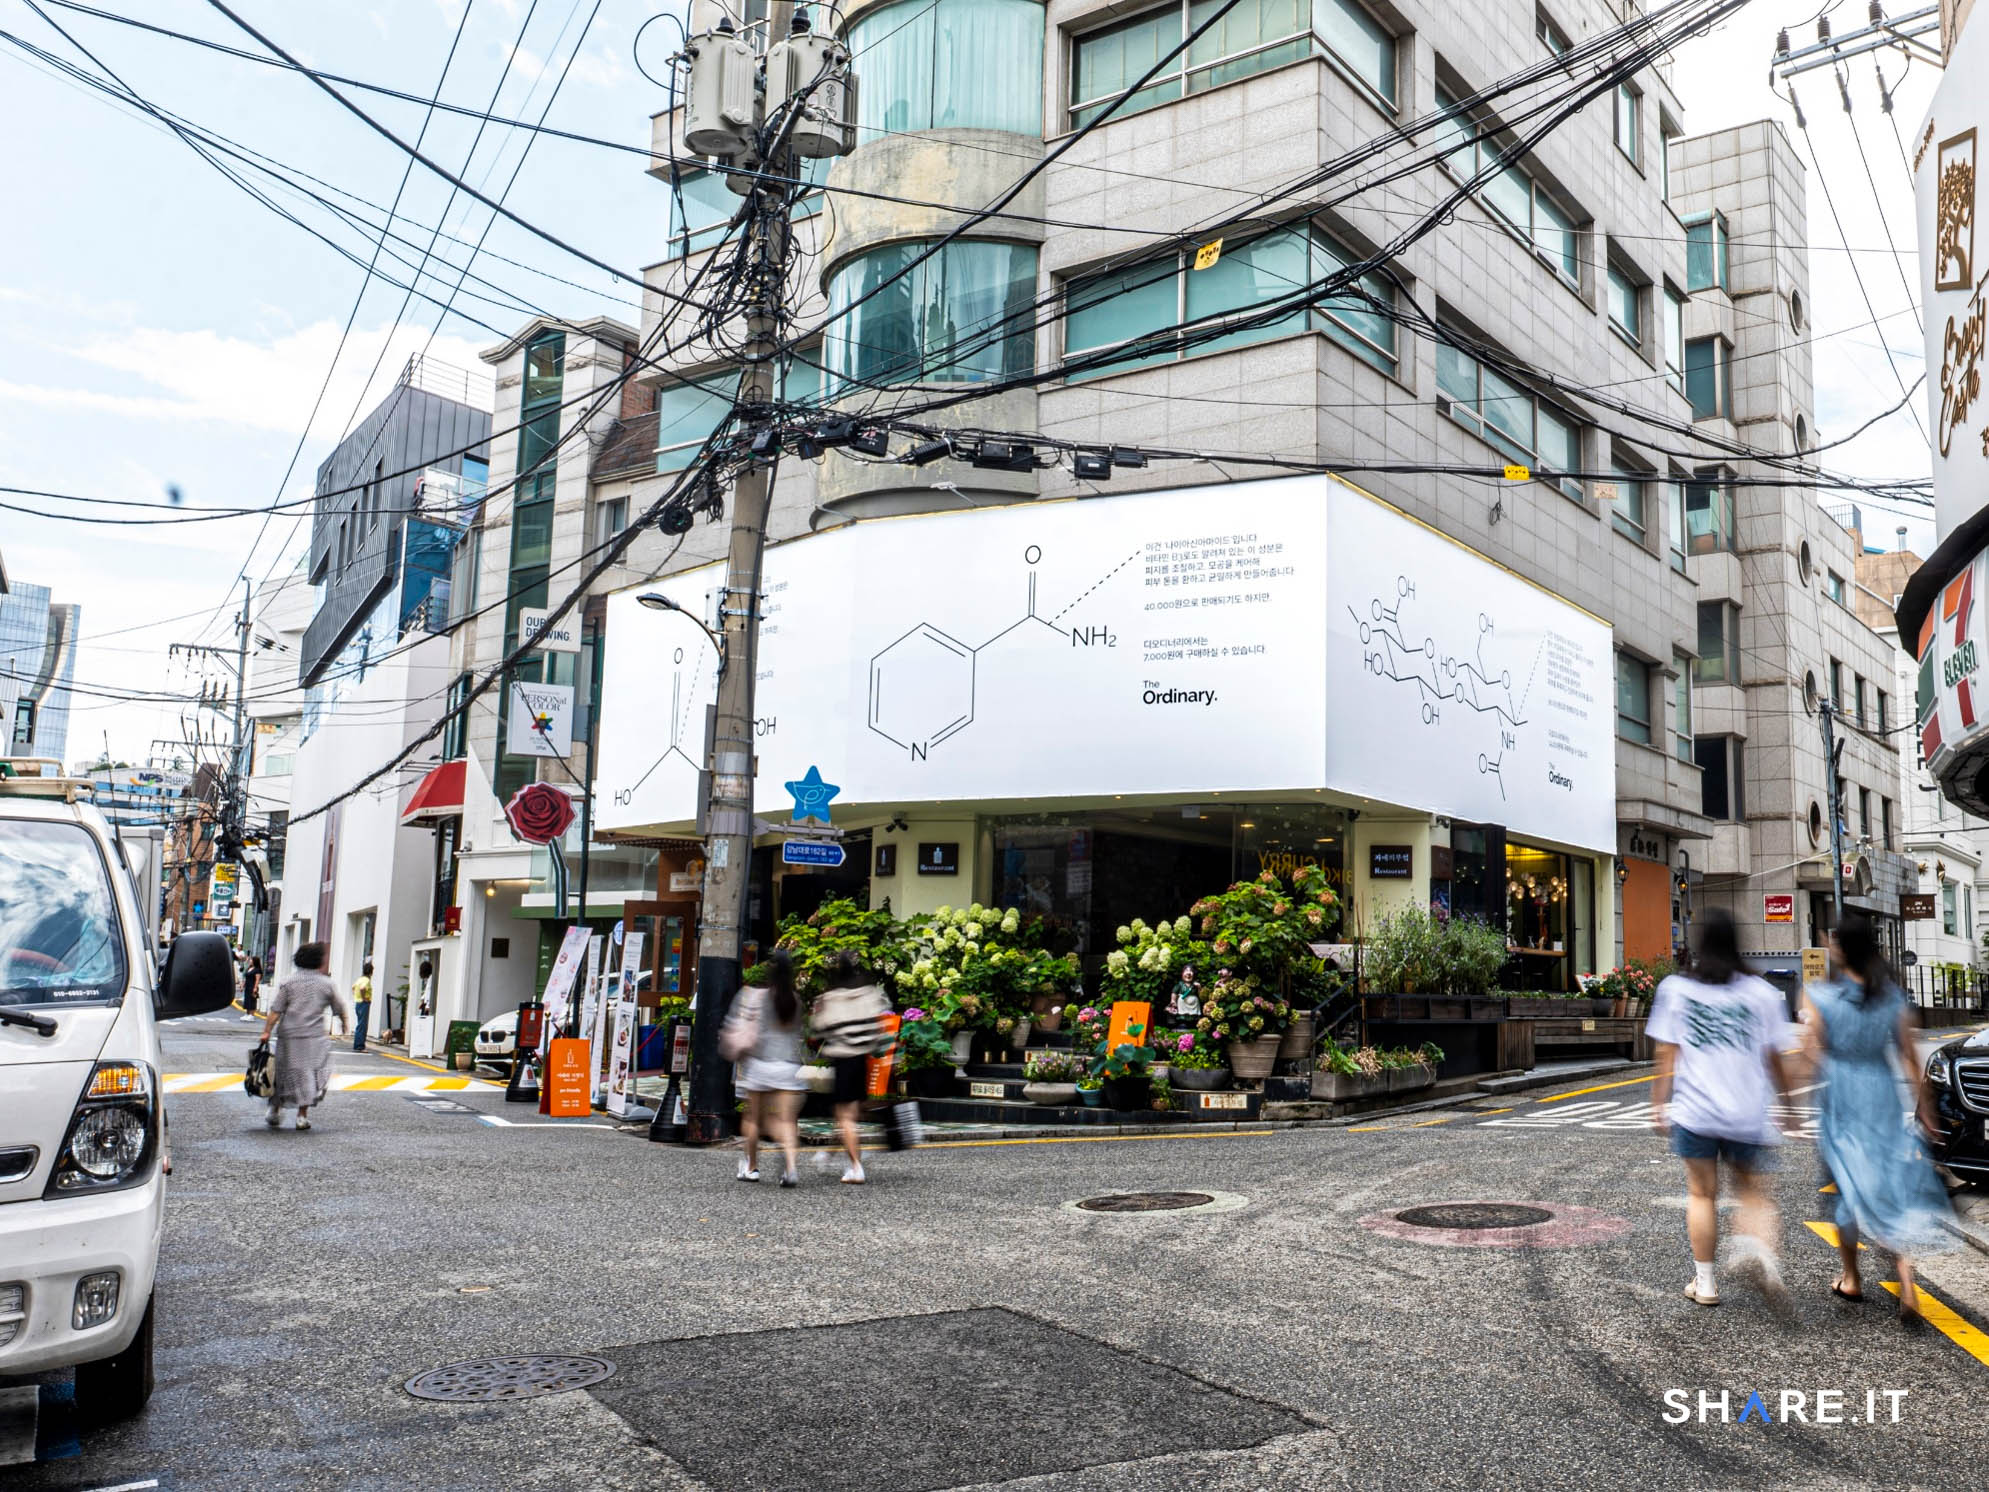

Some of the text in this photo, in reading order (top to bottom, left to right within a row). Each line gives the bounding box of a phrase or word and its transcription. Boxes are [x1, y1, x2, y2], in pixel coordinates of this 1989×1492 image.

[1025, 545, 1041, 564] O
[1145, 541, 1161, 551] 이건
[1145, 553, 1169, 563] 비타민
[1228, 546, 1245, 556] 있는
[1247, 545, 1256, 554] 이
[1258, 543, 1283, 554] 성분은
[1145, 564, 1169, 575] 피지를
[1208, 559, 1232, 570] 모공을
[1145, 577, 1161, 587] 피부
[1163, 575, 1179, 586] 톤을
[1182, 573, 1206, 585] 환하고
[1208, 569, 1242, 583] 균일하게
[1398, 576, 1415, 600] OH
[1479, 613, 1494, 636] OH
[1185, 647, 1218, 659] 구매하실
[1221, 645, 1229, 656] 수
[1365, 650, 1383, 675] HO
[1441, 656, 1457, 678] HO
[1143, 680, 1160, 689] The
[1143, 688, 1218, 706] Ordinary.
[1422, 703, 1440, 726] OH
[756, 717, 776, 736] OH
[1502, 730, 1515, 750] NH
[911, 742, 927, 761] N
[139, 773, 163, 783] NPS
[614, 789, 631, 806] HO
[1374, 867, 1407, 875] Restaurant
